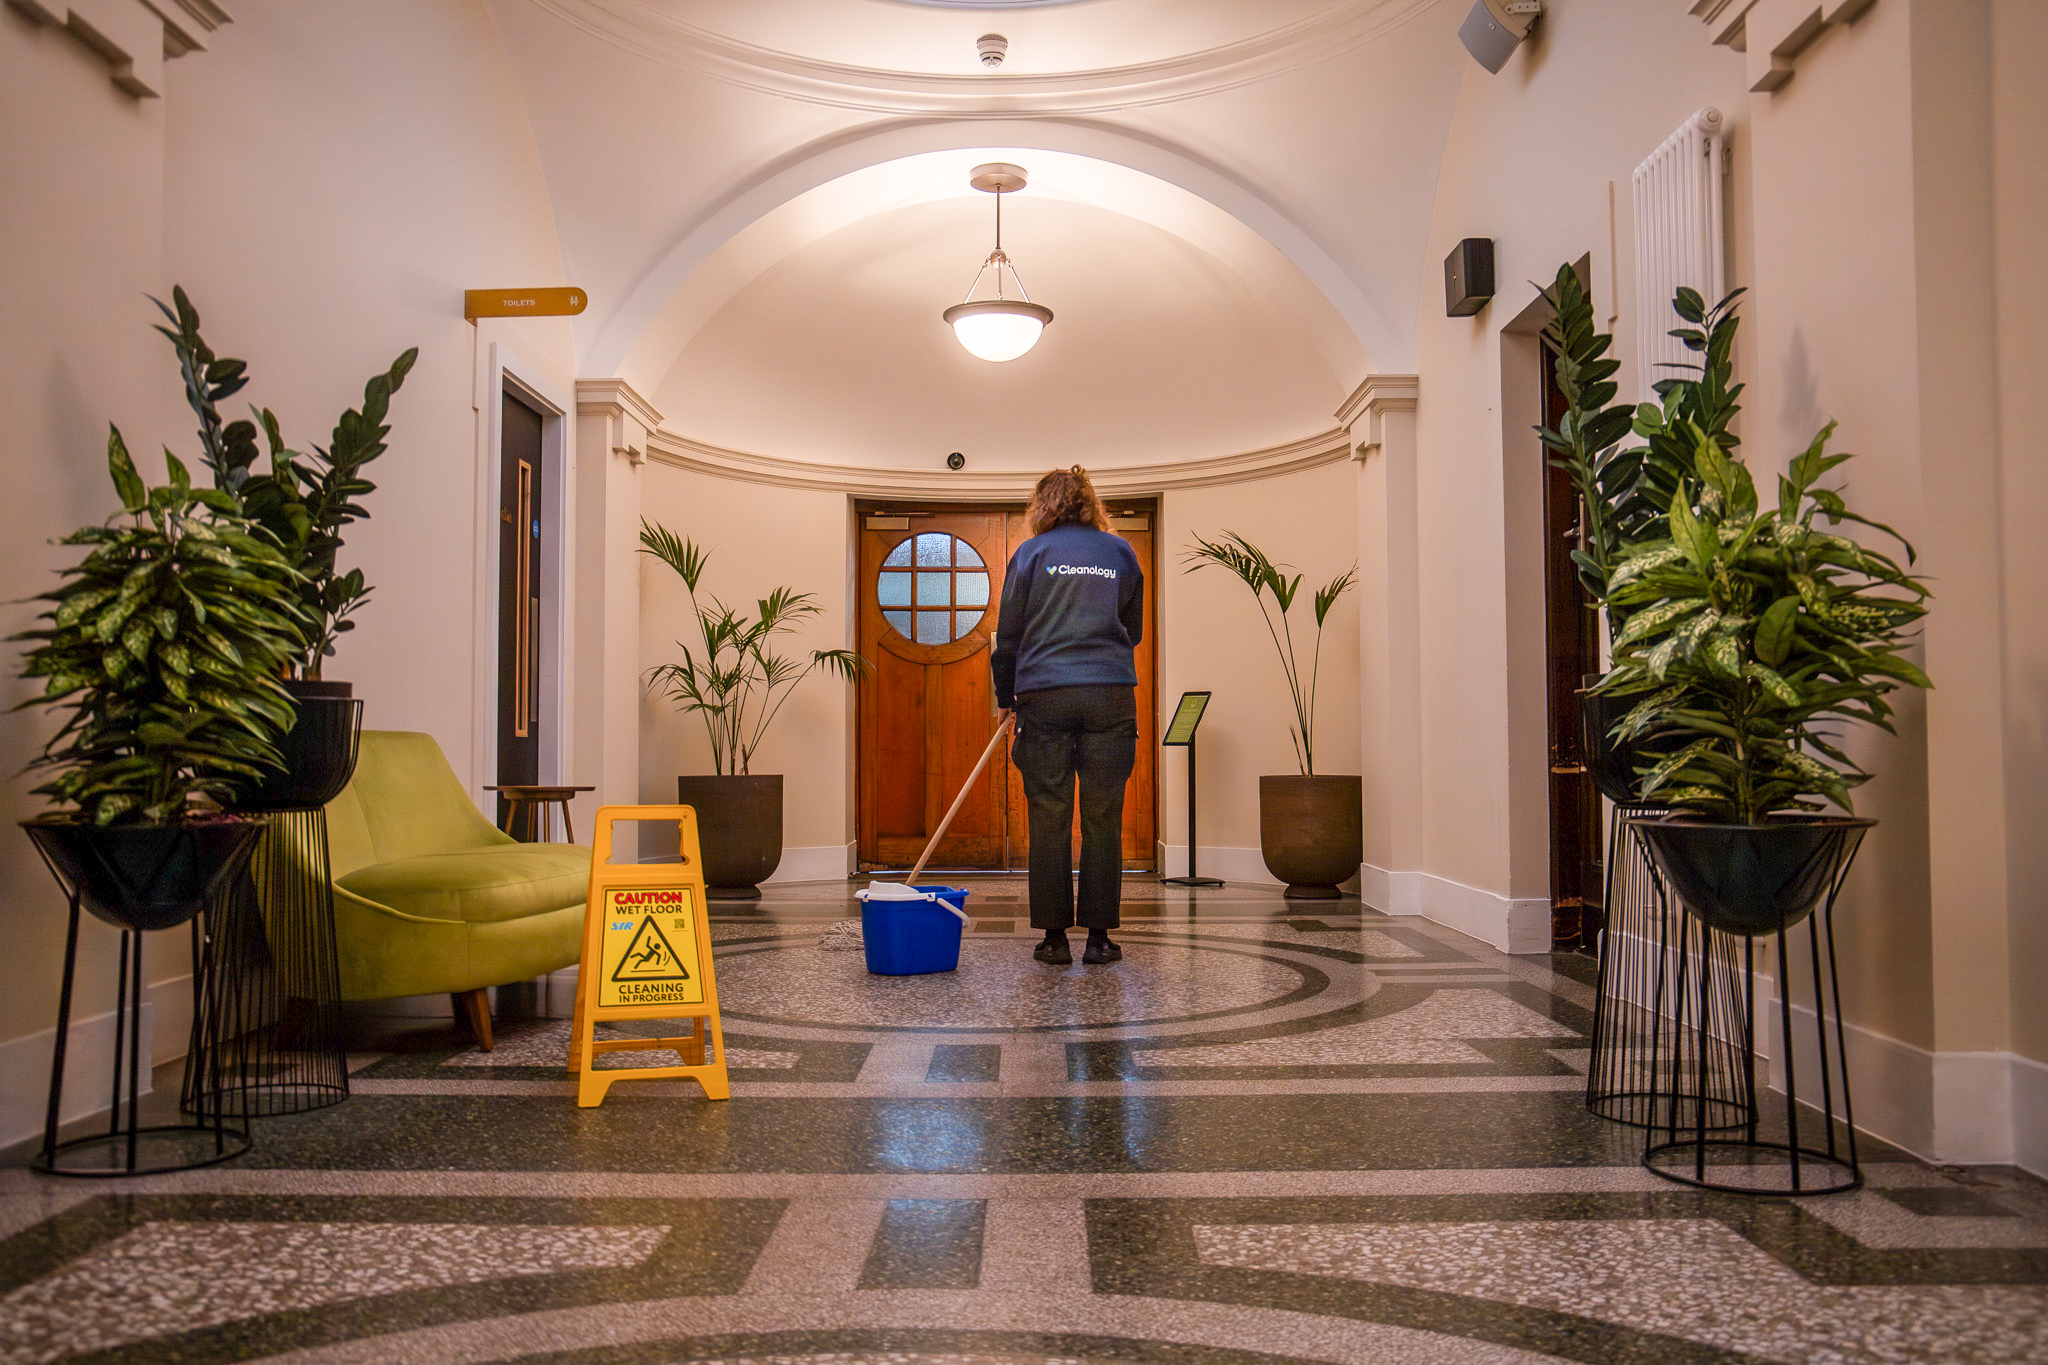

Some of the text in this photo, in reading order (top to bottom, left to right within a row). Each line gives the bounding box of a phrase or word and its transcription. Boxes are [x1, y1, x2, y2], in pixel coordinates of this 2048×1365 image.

[1058, 565, 1116, 578] Cleanology
[614, 892, 682, 904] CAUTION
[616, 905, 682, 914] WET FLOOR
[611, 922, 634, 930] SIR
[618, 983, 684, 994] CLEANING
[619, 993, 684, 1003] IN PROGRESS
